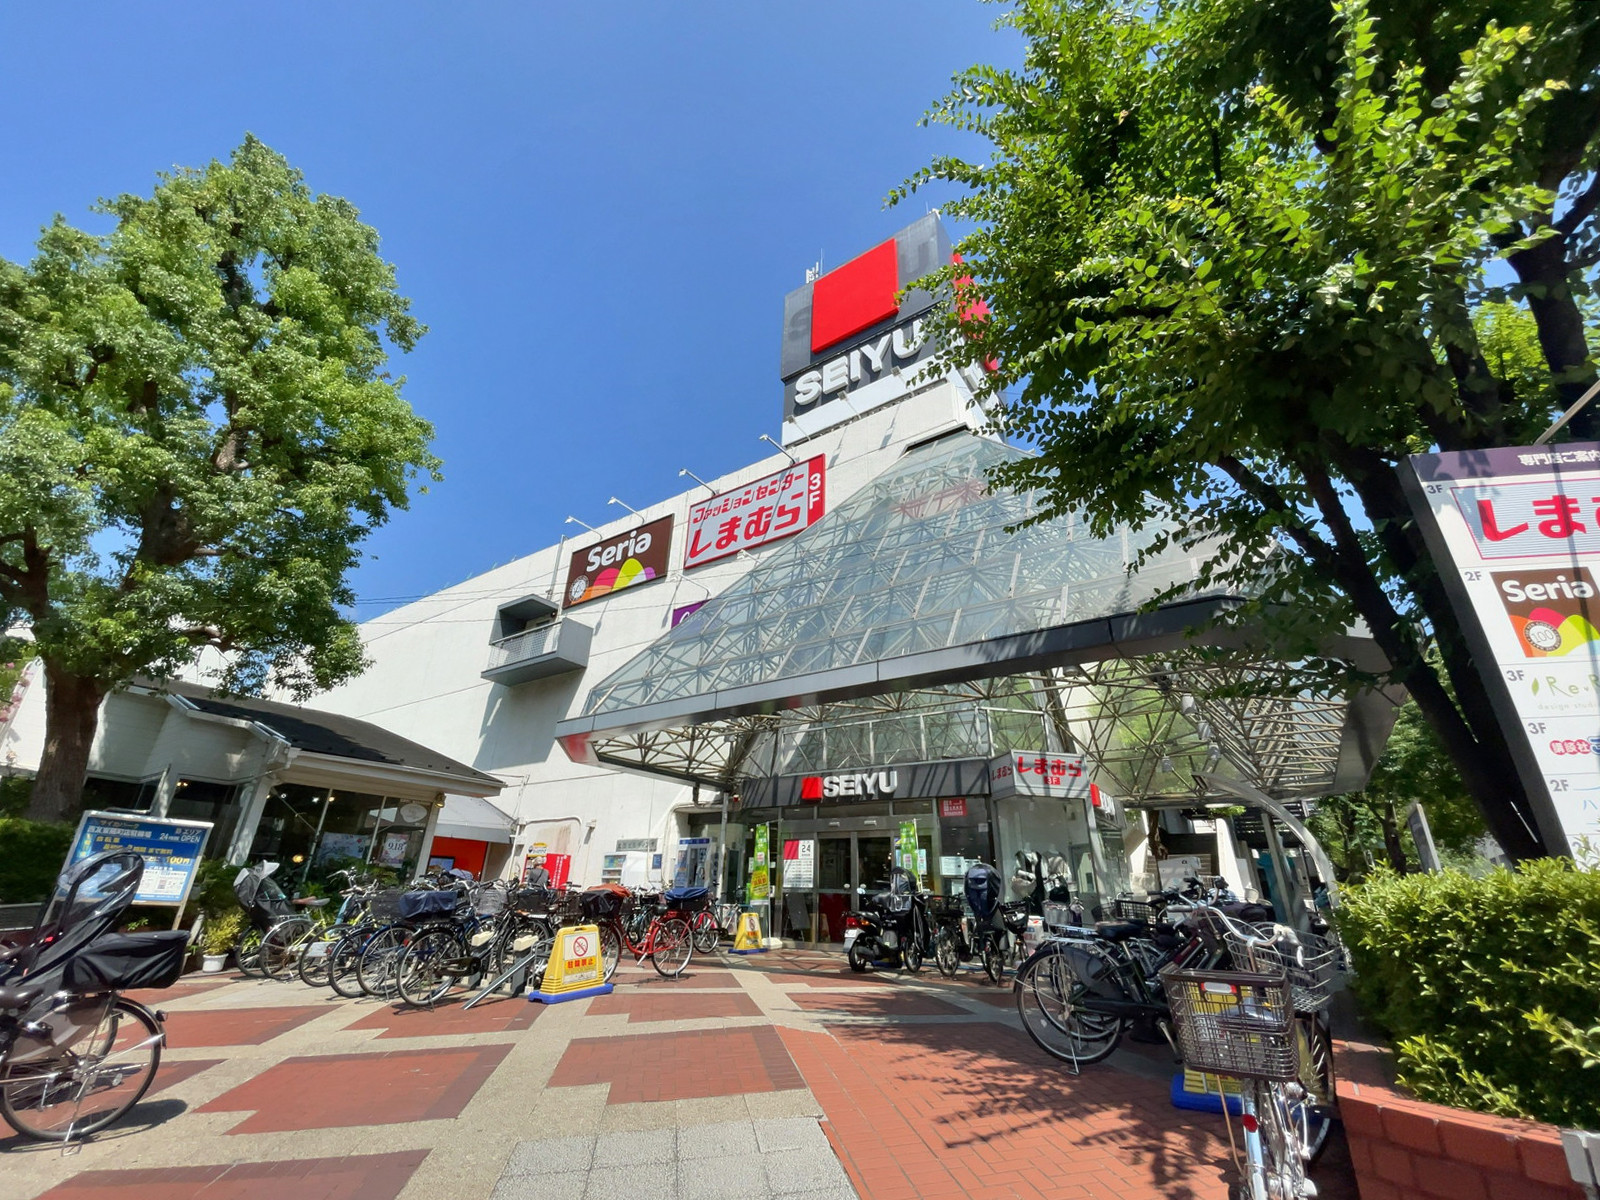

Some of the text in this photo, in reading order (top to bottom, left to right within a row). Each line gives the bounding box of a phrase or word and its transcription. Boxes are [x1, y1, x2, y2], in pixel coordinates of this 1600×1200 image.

[795, 319, 926, 406] SEIYU
[693, 473, 805, 524] ファッションセンター
[808, 472, 822, 510] 3F
[1427, 483, 1443, 495] 3F
[689, 492, 804, 559] しまむら
[1476, 494, 1600, 542] しま
[586, 530, 652, 572] Seria
[1464, 571, 1482, 582] 2F
[1501, 575, 1595, 603] Seria
[1506, 669, 1525, 682] 3F
[1528, 722, 1547, 735] 3F
[1017, 756, 1082, 777] しまむら
[823, 770, 898, 798] SEIYU
[1550, 779, 1569, 792] 2F
[180, 834, 201, 843] OPEN
[801, 843, 812, 853] 24
